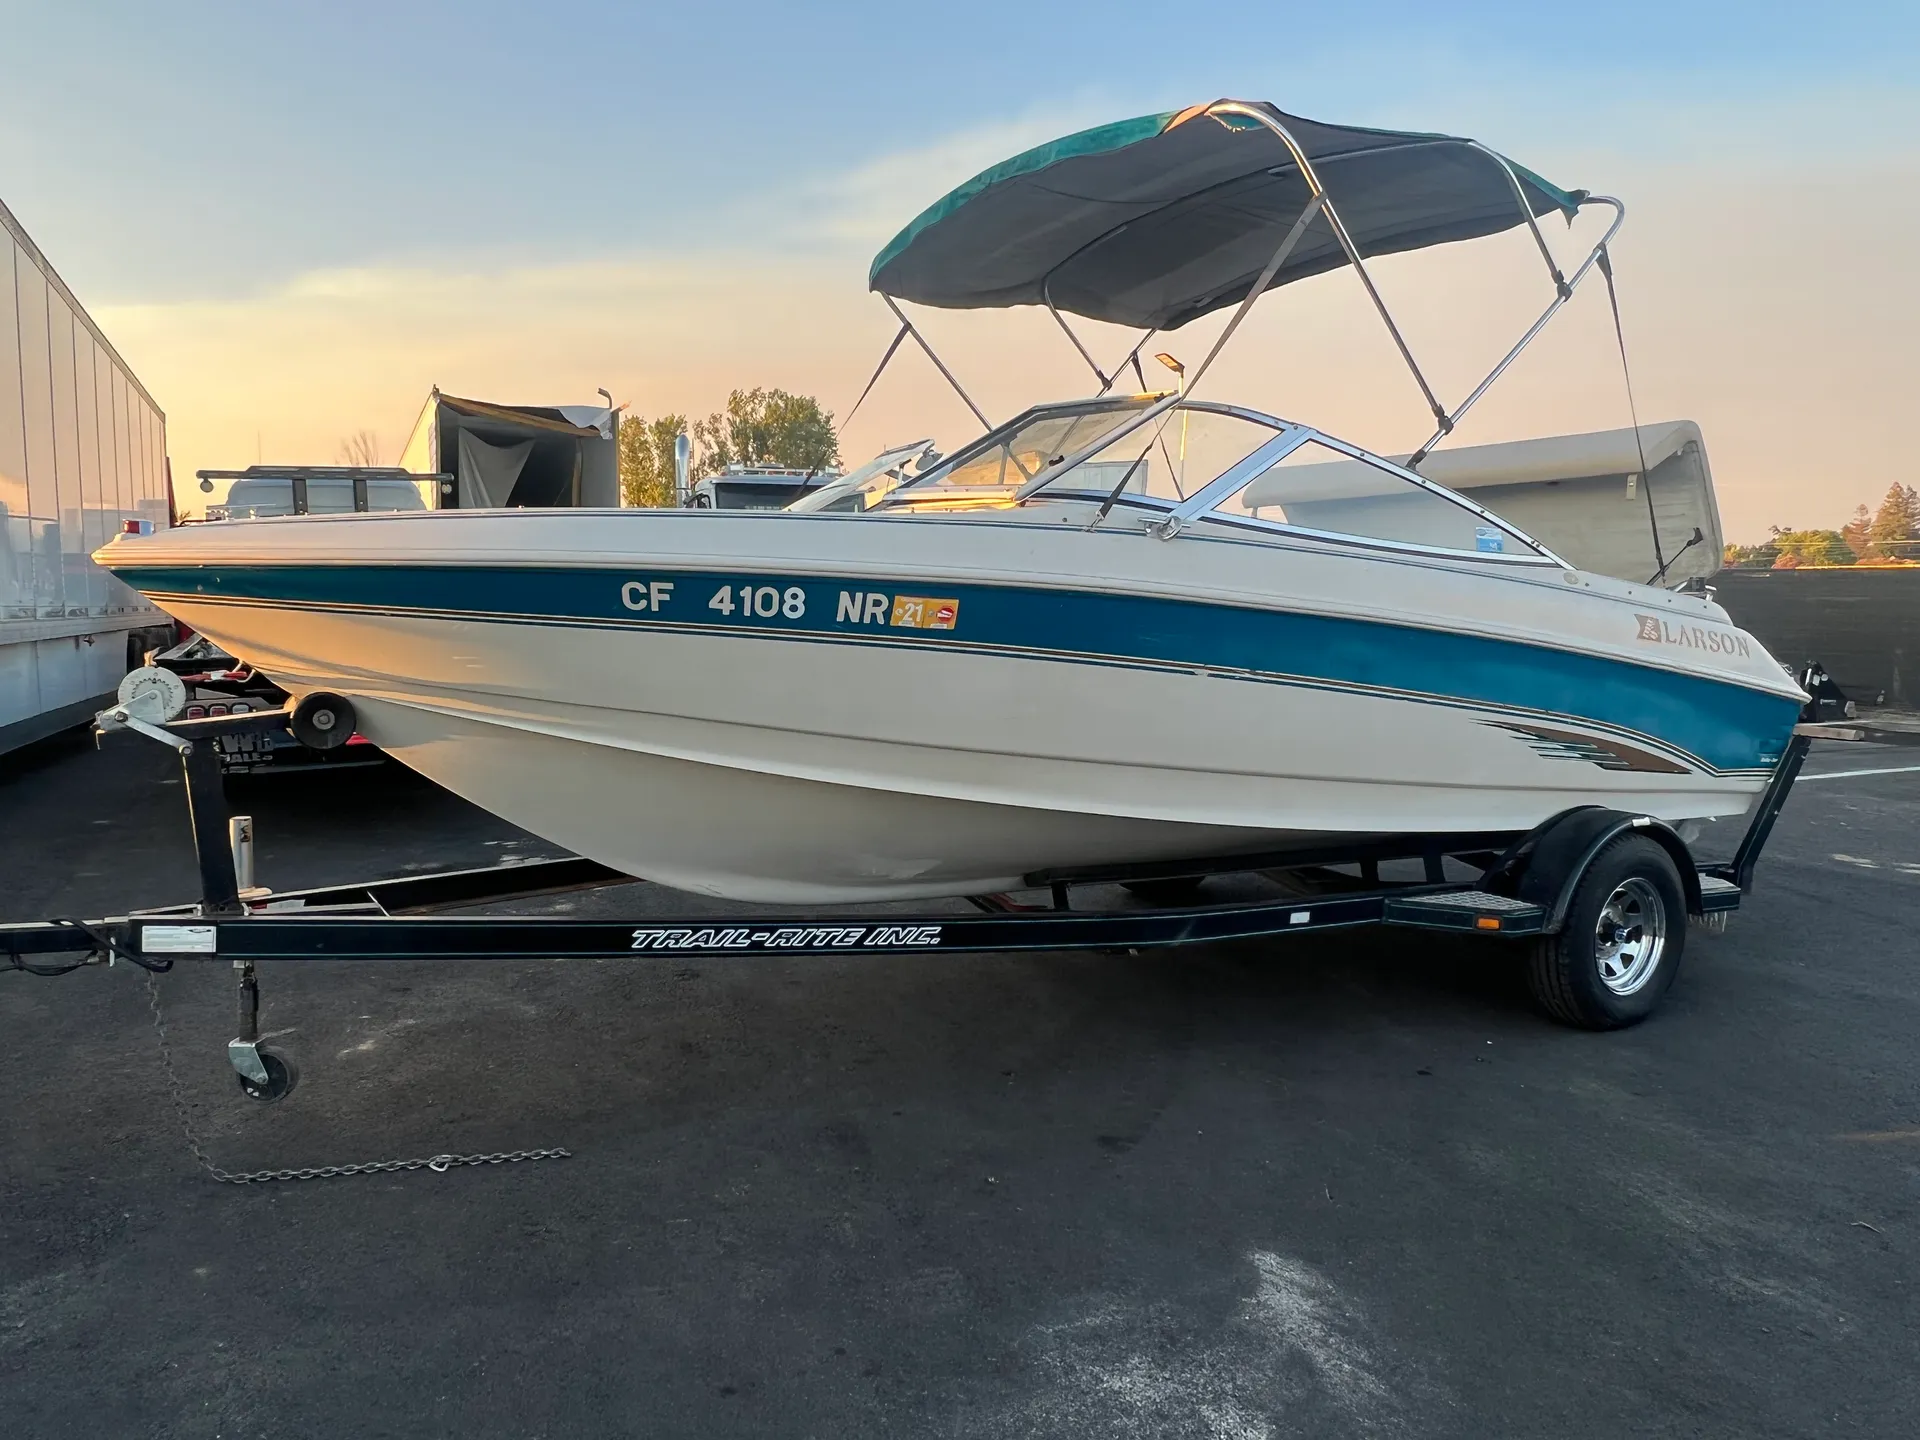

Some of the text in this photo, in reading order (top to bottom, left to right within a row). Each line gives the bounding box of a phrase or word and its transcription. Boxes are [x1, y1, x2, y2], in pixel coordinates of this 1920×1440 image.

[621, 581, 889, 625] CF 4108 NR
[902, 603, 923, 622] 21
[1663, 620, 1750, 658] LARSON
[631, 927, 942, 948] TRAIL-RITE INC.
